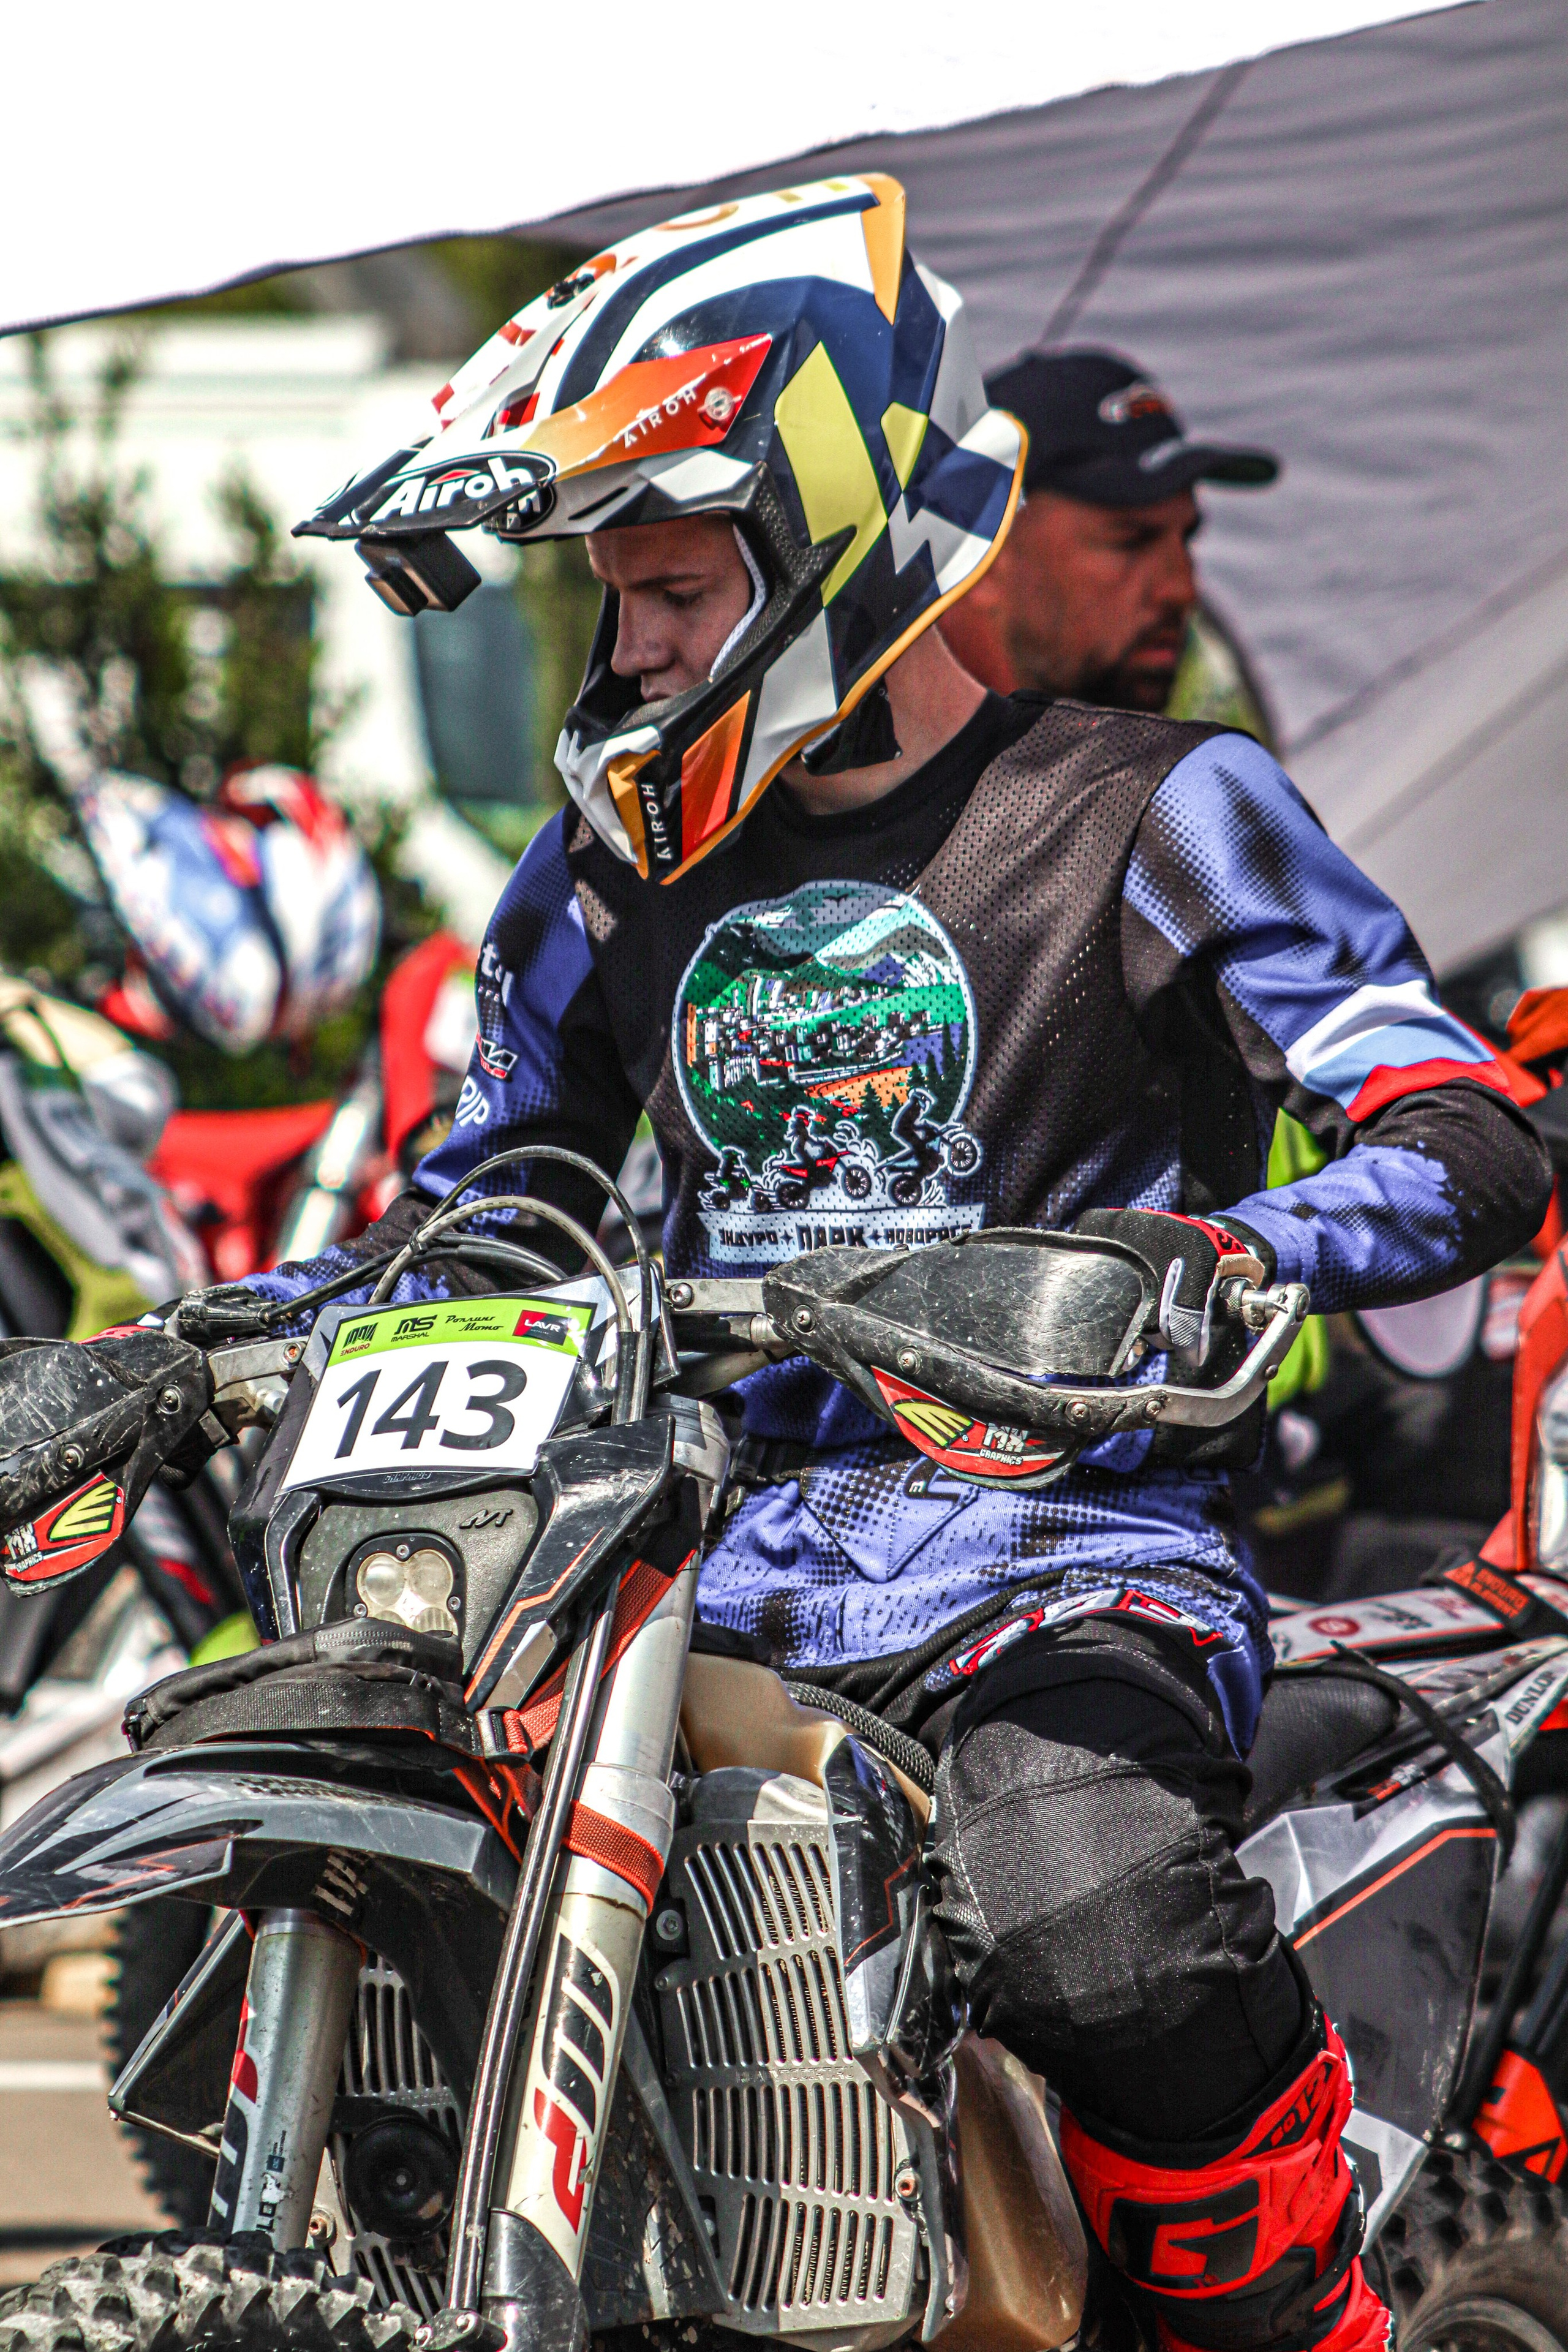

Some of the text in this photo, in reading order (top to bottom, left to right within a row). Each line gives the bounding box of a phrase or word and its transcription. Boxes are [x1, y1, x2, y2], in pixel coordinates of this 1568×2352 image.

[623, 381, 696, 449] AIROH
[368, 456, 535, 524] Airoh
[641, 783, 671, 860] AIROH
[339, 1343, 371, 1356] ENDURO
[390, 1332, 429, 1343] MARSHAL
[524, 1319, 560, 1333] LAVR
[334, 1359, 528, 1460] 143
[979, 1448, 1023, 1466] GRAPHICS
[1504, 1671, 1556, 1725] DUNLOP
